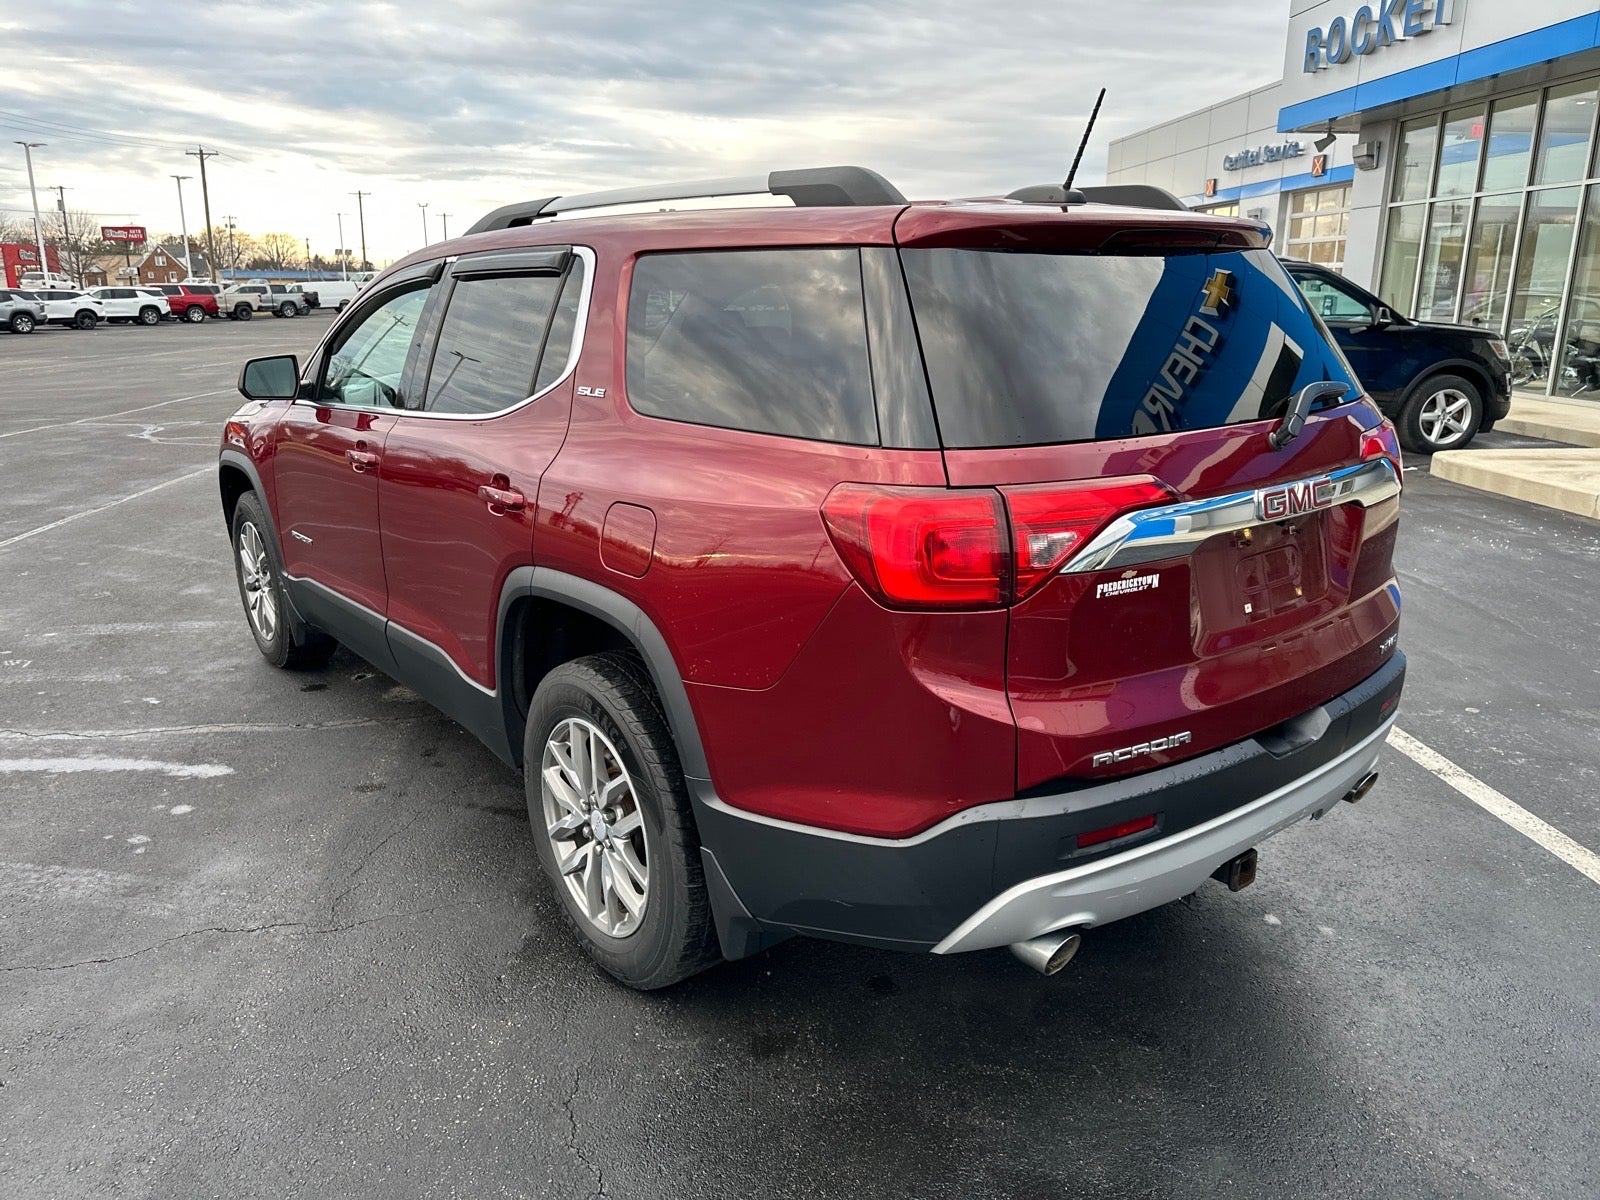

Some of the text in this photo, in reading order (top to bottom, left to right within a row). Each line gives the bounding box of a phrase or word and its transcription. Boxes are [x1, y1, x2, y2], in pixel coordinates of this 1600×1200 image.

[1223, 140, 1302, 171] Certified Service
[576, 386, 606, 398] SLE
[1263, 479, 1333, 519] GMC
[1096, 573, 1160, 599] FREDERICKTOWN
[1105, 585, 1149, 597] CHEVROLET
[1092, 731, 1192, 768] ACADIA
